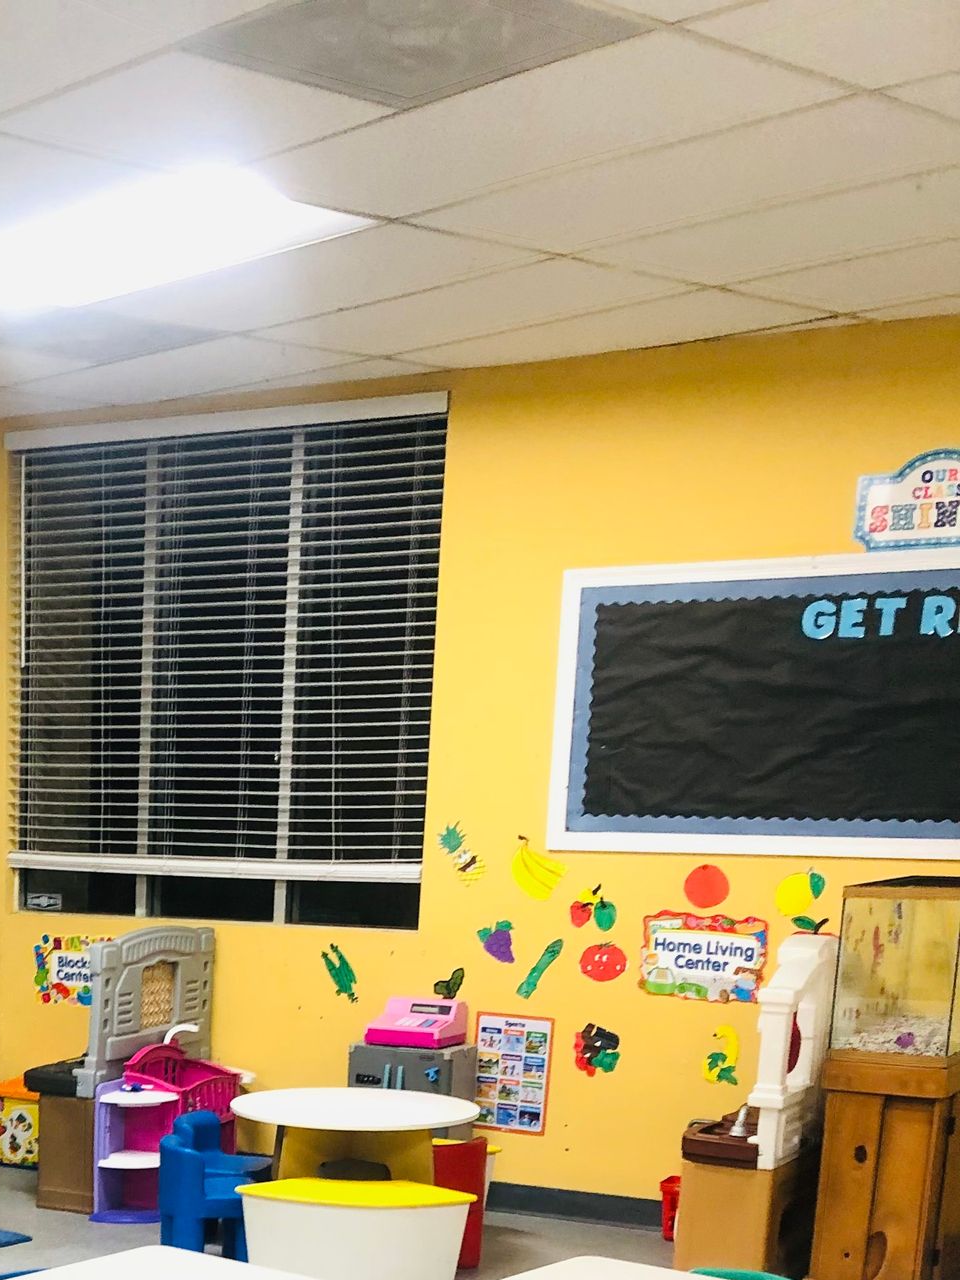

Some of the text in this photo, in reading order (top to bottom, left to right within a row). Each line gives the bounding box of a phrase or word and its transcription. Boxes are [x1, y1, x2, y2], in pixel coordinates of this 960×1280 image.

[921, 469, 959, 483] OUR
[802, 597, 908, 640] GET
[654, 937, 755, 962] Home Living
[674, 954, 728, 972] Center
[504, 1020, 526, 1028] Sports
